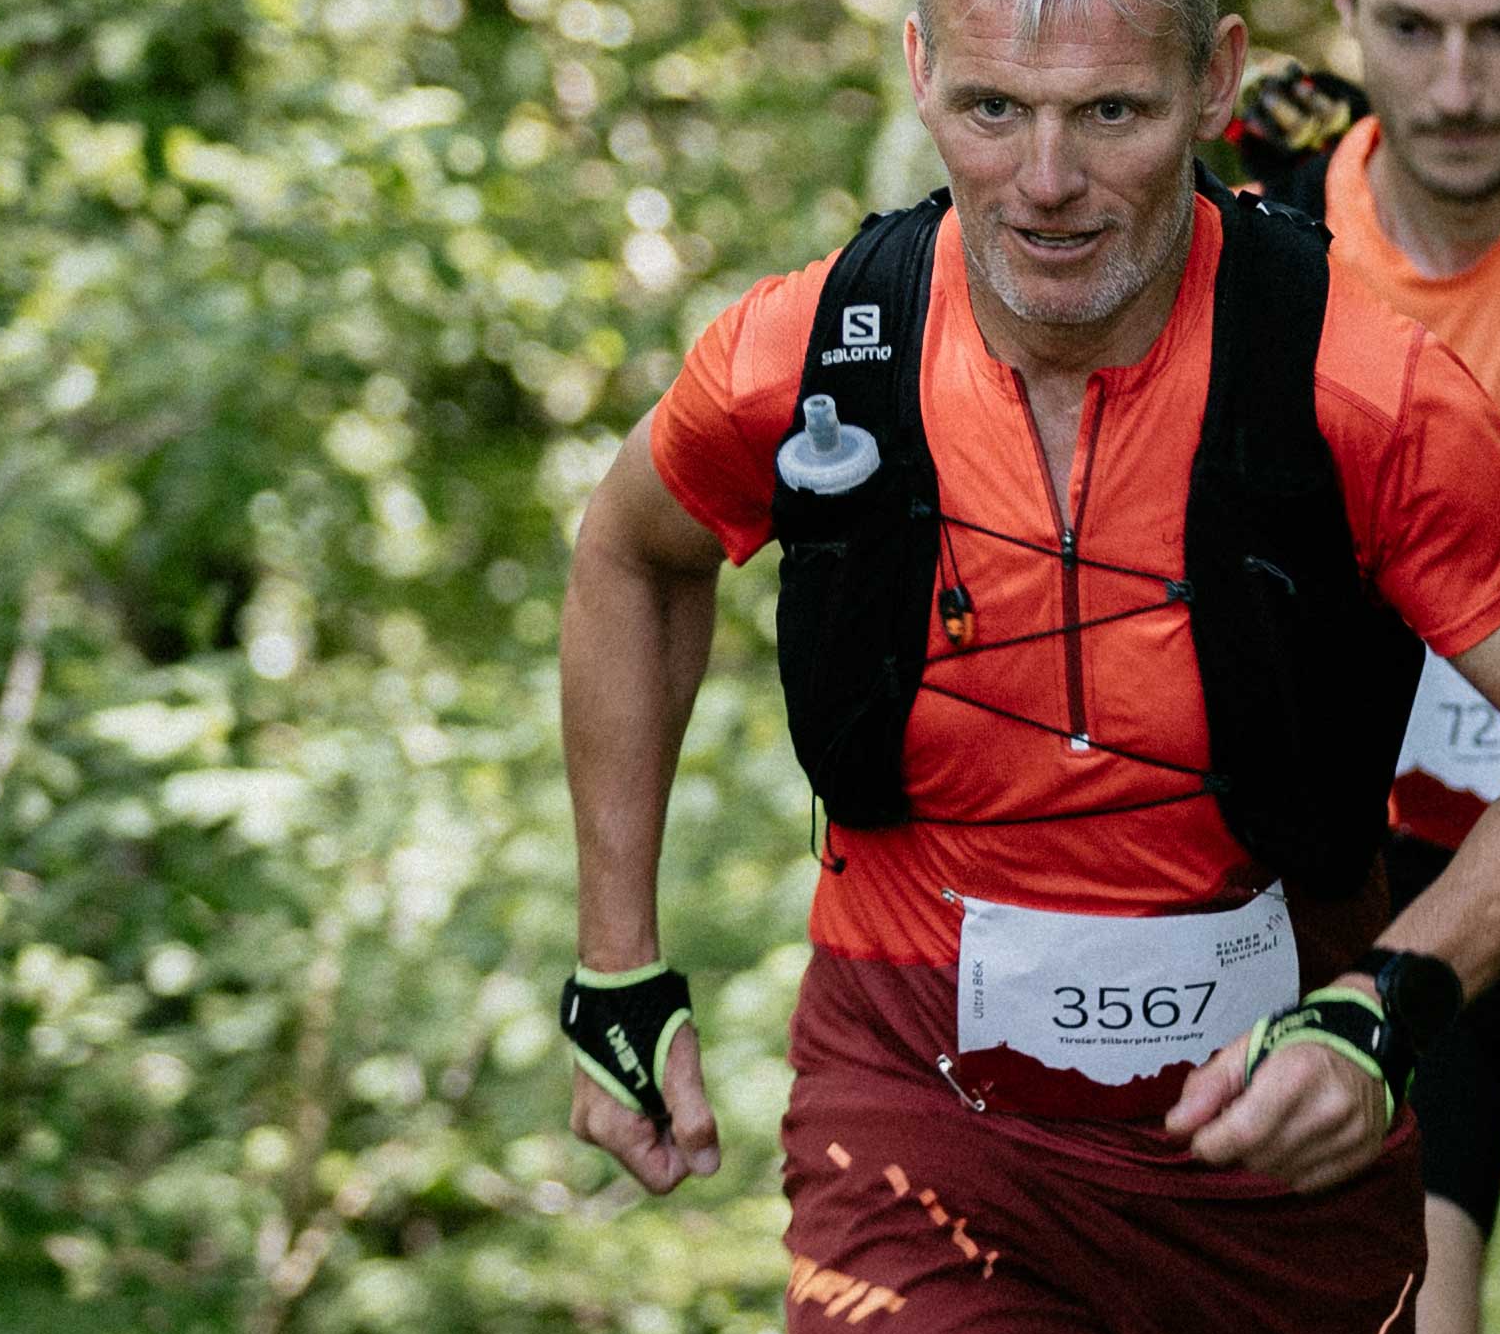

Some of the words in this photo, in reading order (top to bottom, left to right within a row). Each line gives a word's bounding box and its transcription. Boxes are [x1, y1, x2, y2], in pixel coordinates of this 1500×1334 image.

[1215, 932, 1260, 950] SILBER
[1215, 940, 1261, 957] REGION
[972, 989, 984, 1019] Ultra
[1052, 981, 1218, 1030] 3567
[1058, 1036, 1097, 1045] Tiroler
[1100, 1035, 1161, 1047] Silberpfad
[1164, 1031, 1204, 1042] Trophy
[605, 1022, 649, 1090] LEKI
